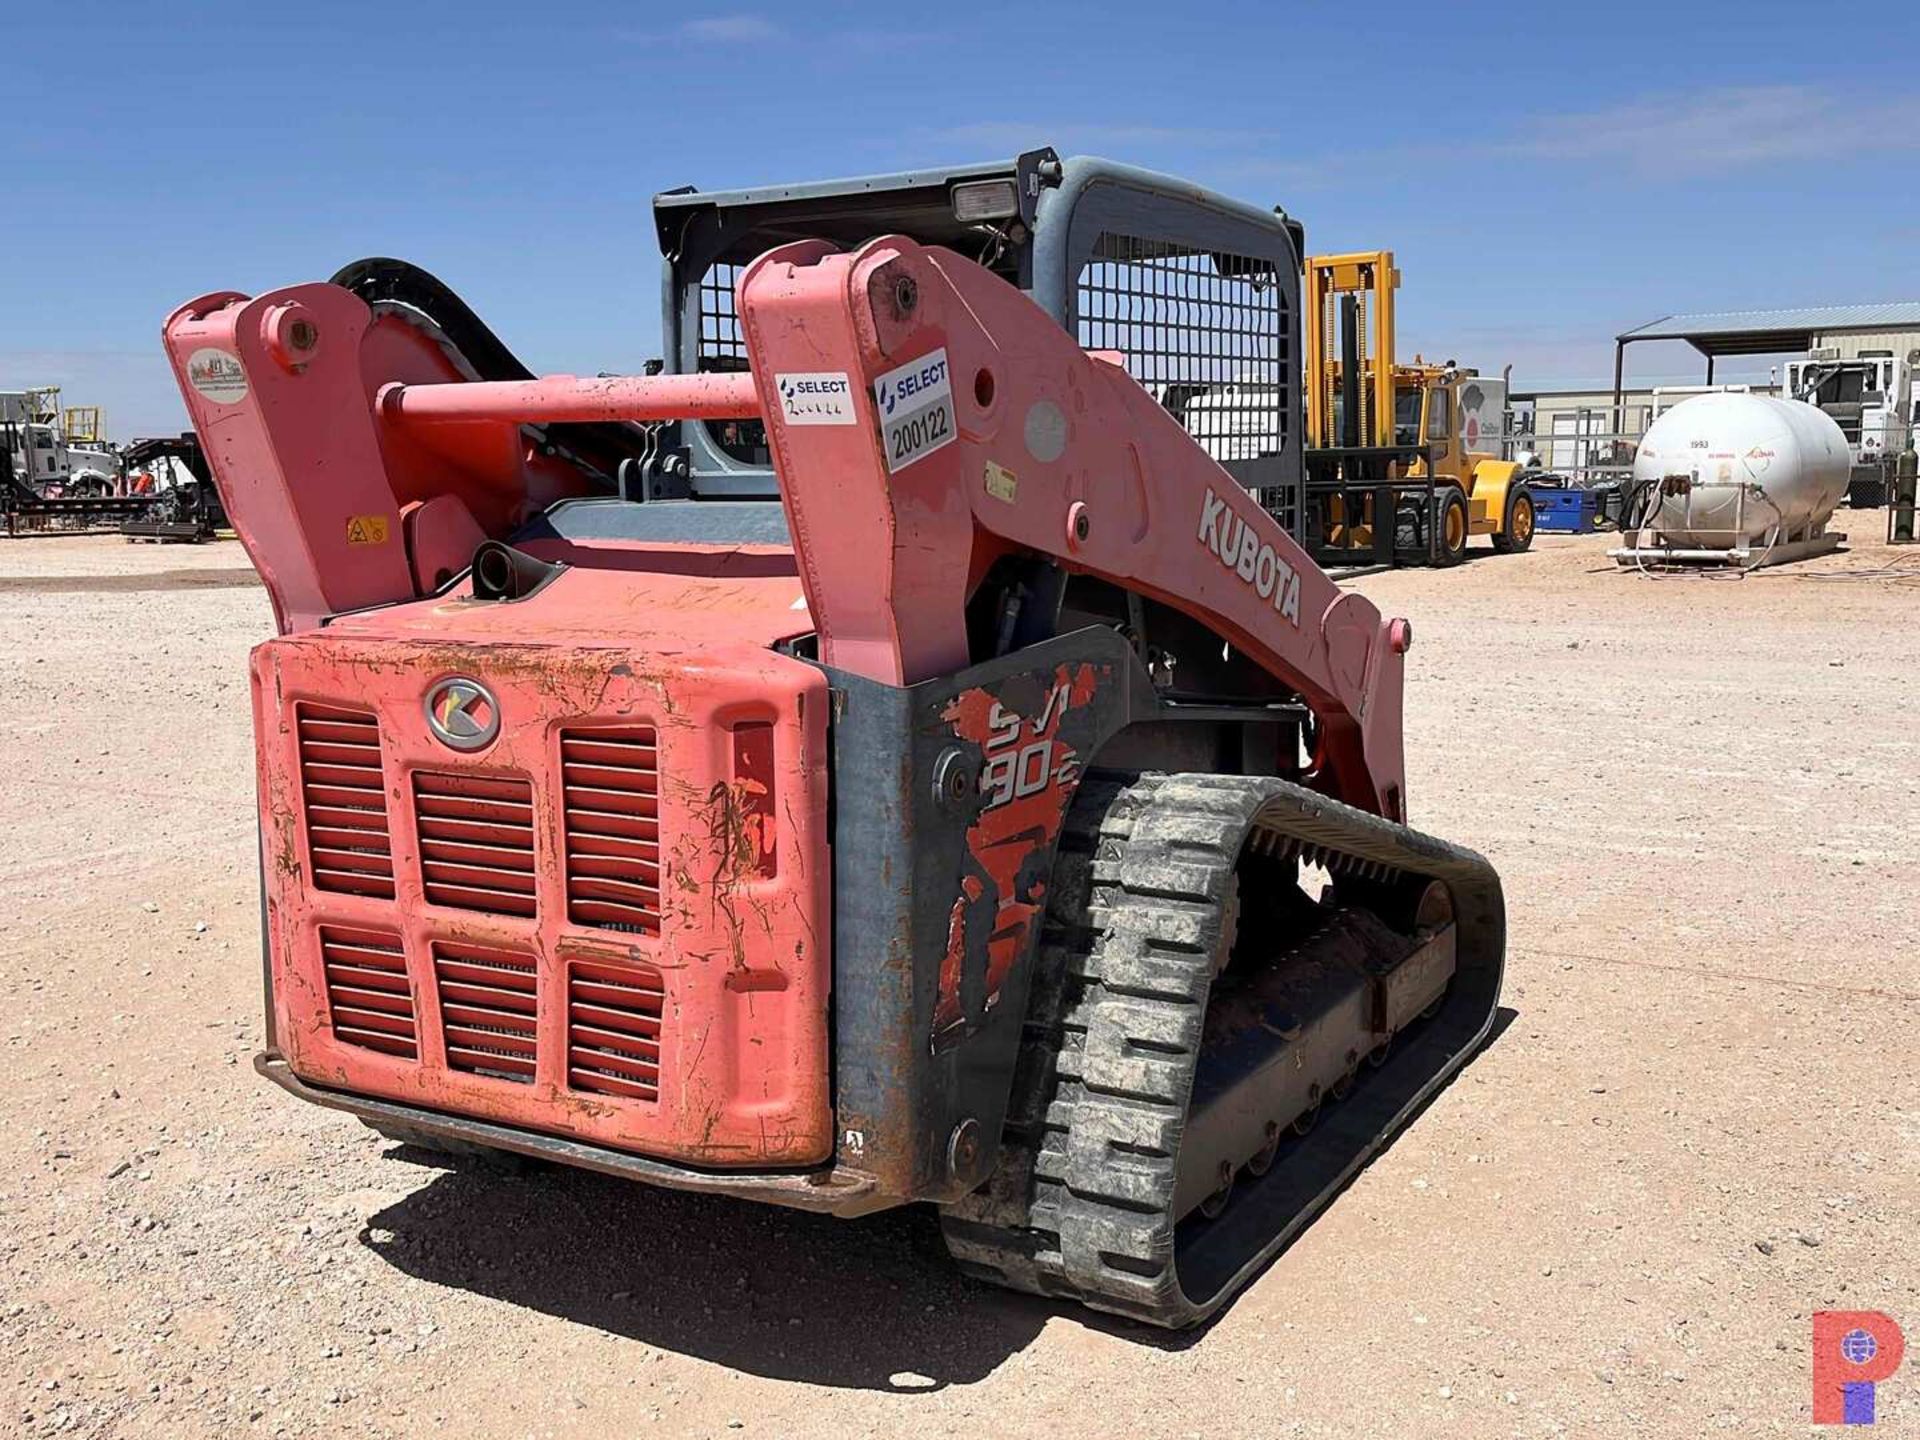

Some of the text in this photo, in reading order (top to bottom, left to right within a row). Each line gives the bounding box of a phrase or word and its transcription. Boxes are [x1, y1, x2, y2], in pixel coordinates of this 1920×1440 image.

[797, 381, 847, 394] SELECT
[897, 360, 946, 400] SELECT
[892, 406, 948, 460] 200122
[1198, 487, 1302, 629] KUBOTA
